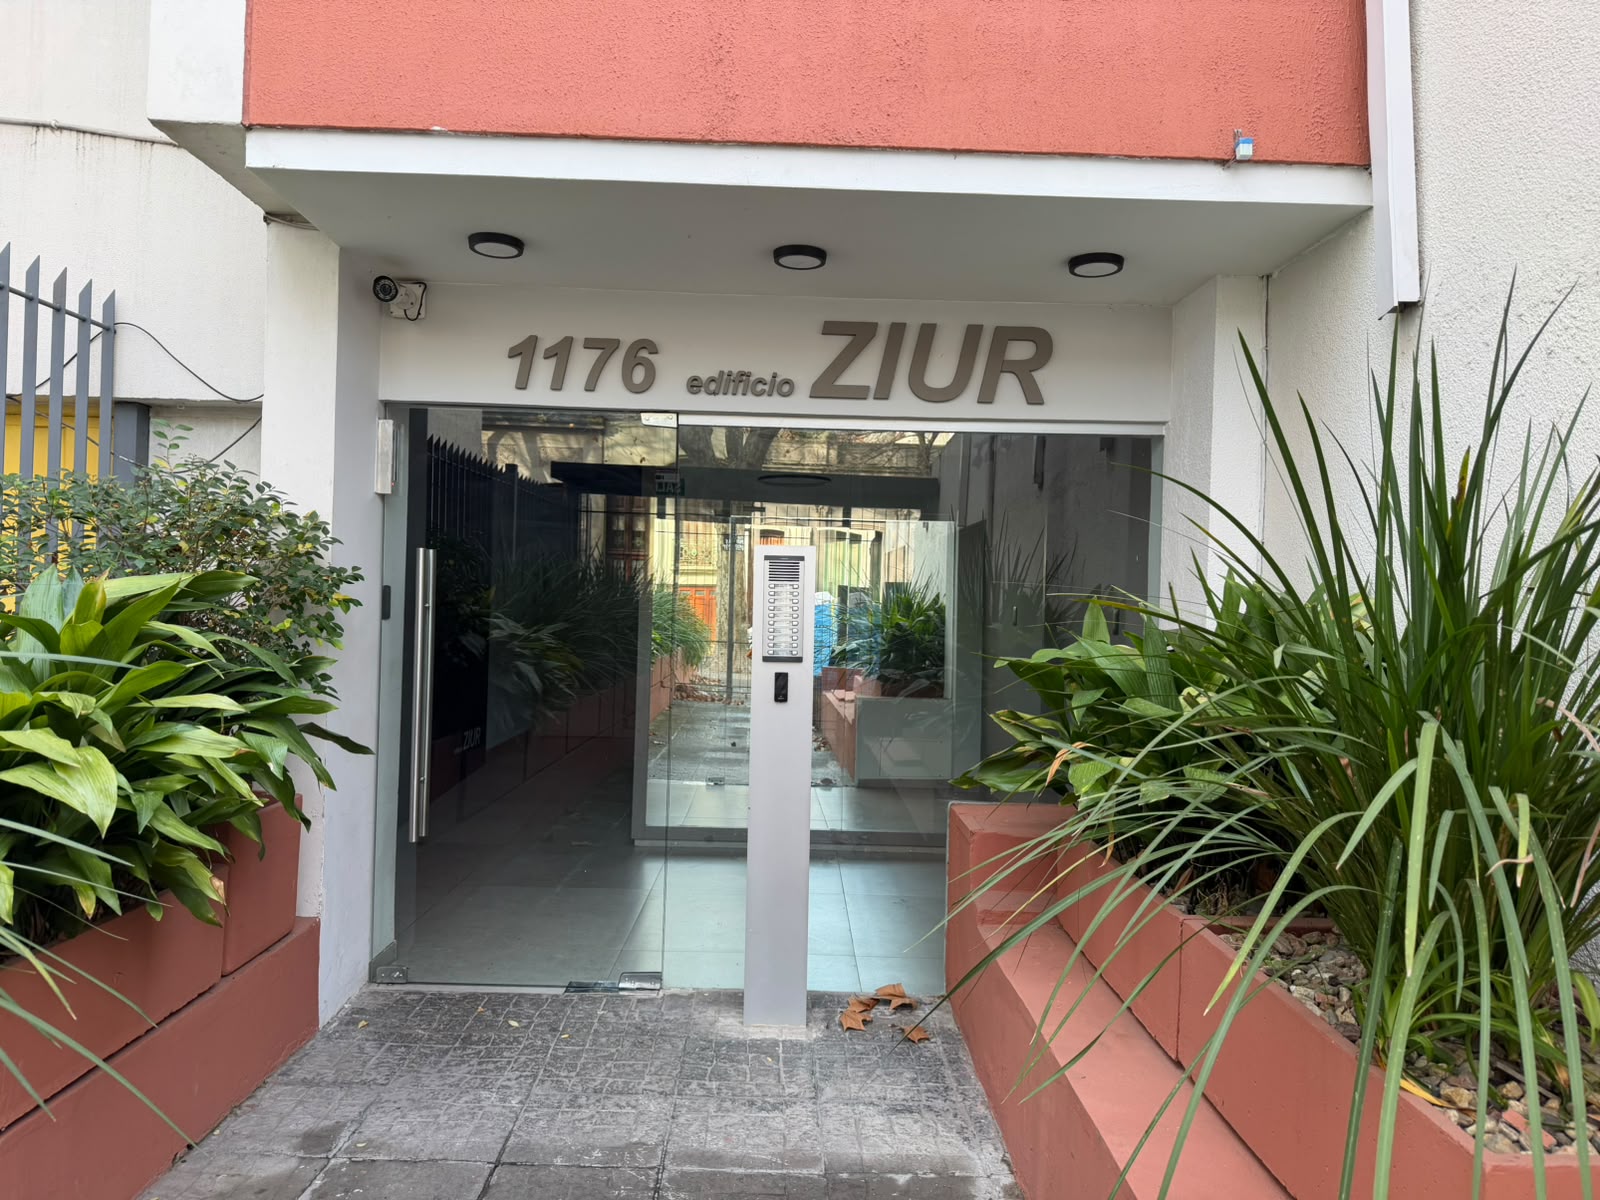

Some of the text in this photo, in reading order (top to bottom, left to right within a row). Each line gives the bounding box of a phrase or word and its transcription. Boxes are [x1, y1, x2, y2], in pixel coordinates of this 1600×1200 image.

[507, 320, 1054, 405] 1176 edificio ZIUR
